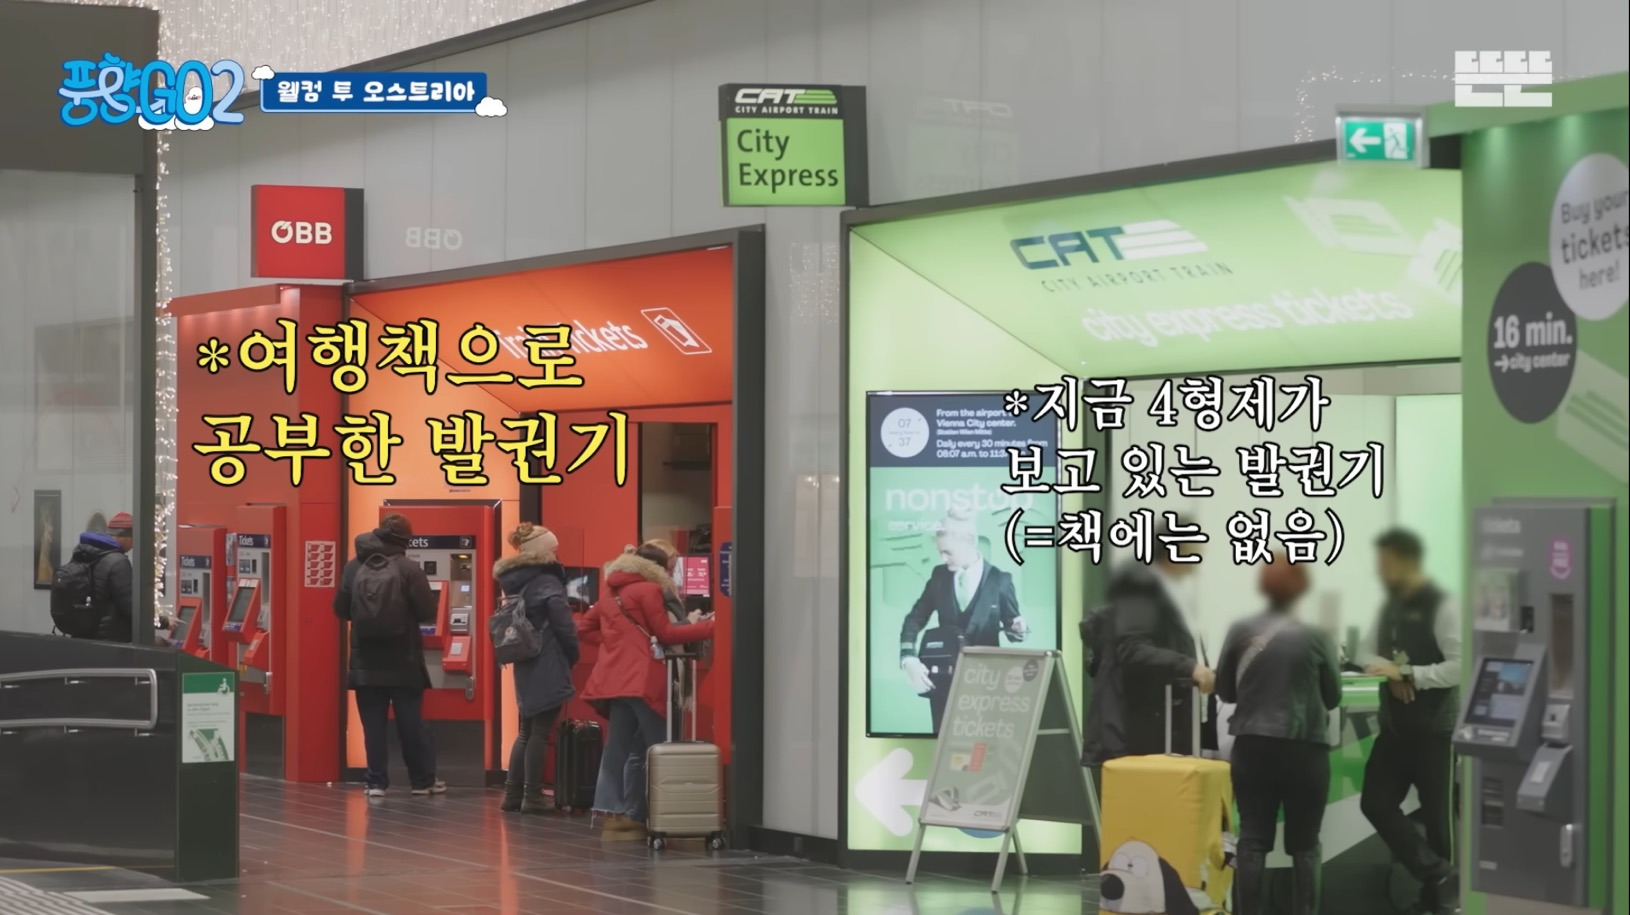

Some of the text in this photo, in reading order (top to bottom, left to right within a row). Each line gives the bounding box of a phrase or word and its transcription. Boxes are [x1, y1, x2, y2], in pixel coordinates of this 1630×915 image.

[735, 88, 806, 104] CAT
[735, 106, 838, 115] CITY AIRPORT TRAIN
[737, 128, 790, 161] City
[739, 162, 839, 194] Express
[1562, 202, 1590, 224] Buy
[1041, 261, 1234, 293] CITY AIRPORT TRAIN
[1082, 287, 1414, 347] city express tickets
[1493, 312, 1573, 349] 16 min.
[1509, 351, 1571, 373] city center
[936, 409, 959, 417] From
[960, 409, 975, 417] the
[976, 409, 1007, 418] airport
[936, 419, 966, 427] Vienna
[966, 418, 986, 429] City
[936, 439, 957, 449] Daily
[957, 440, 981, 450] every
[981, 439, 994, 448] 30
[979, 450, 989, 458] to
[239, 534, 254, 546] Tickets
[964, 663, 1000, 691] city
[958, 694, 1030, 716] express
[953, 714, 1014, 738] tickets
